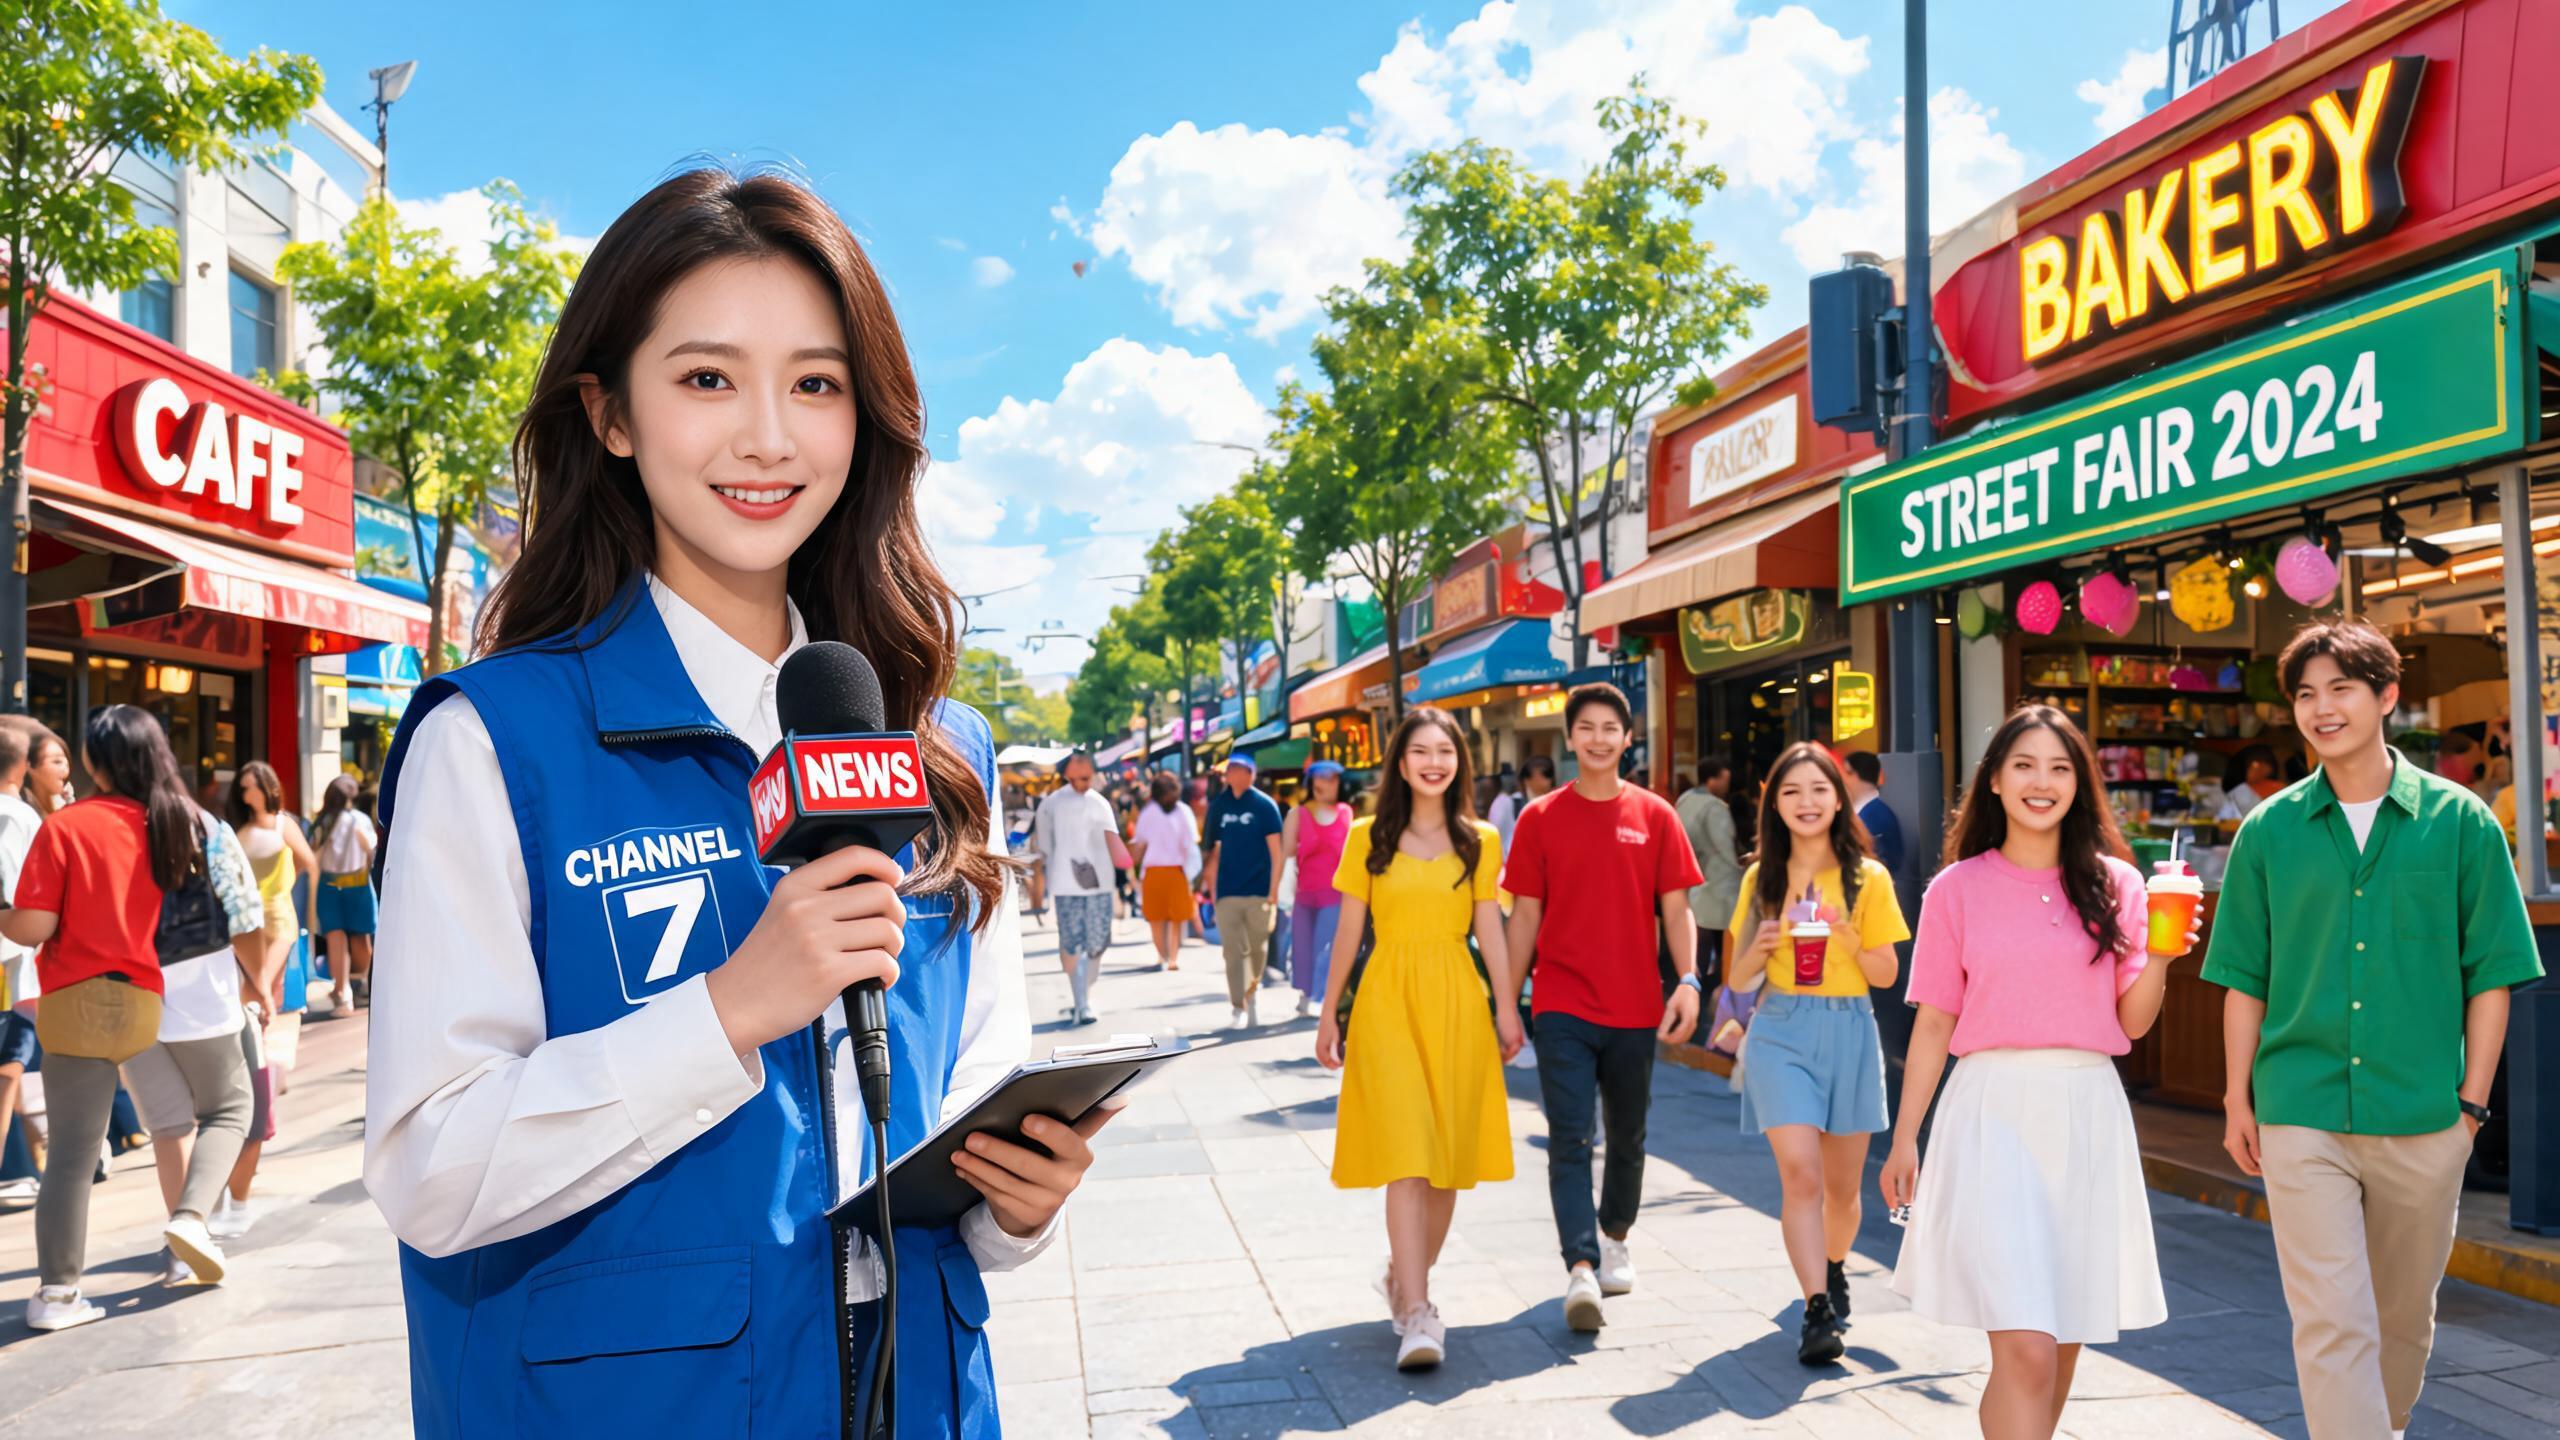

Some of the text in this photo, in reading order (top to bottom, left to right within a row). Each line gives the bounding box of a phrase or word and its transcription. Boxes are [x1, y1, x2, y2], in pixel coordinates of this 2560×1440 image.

[2020, 60, 2393, 360] BAKERY
[134, 378, 304, 526] CAFE
[1901, 448, 2060, 557] STREET
[2073, 407, 2195, 514] FAIR
[2212, 351, 2384, 480] 2024
[804, 752, 918, 800] NEWS
[565, 827, 742, 887] CHANNEL
[624, 878, 706, 983] 7
